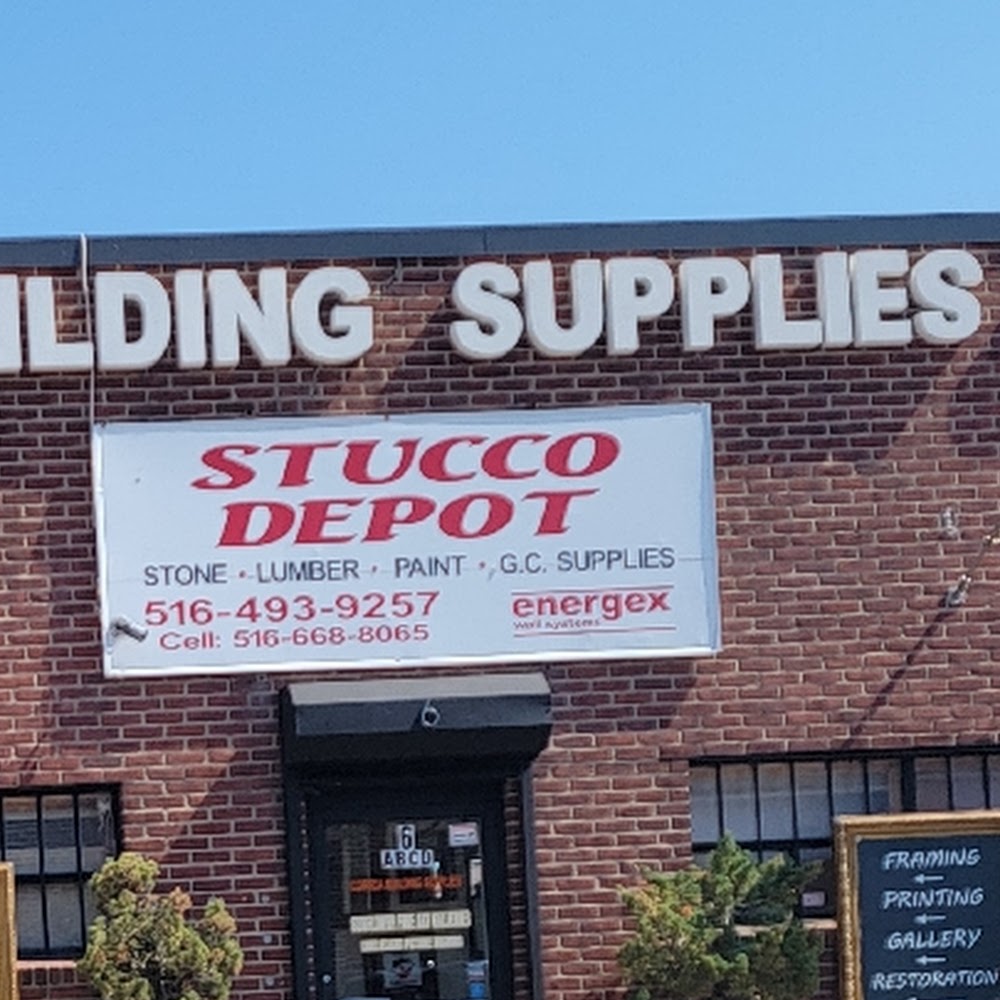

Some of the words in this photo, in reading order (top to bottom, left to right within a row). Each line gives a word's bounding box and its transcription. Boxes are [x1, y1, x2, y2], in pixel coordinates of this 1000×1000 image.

[449, 249, 984, 360] SUPPLIES
[191, 431, 622, 492] STUCCO
[215, 488, 601, 548] DEPOT
[143, 563, 228, 587] STONE
[256, 559, 359, 584] LUMBER
[394, 555, 467, 579] PAINT
[499, 551, 548, 575] G.C.
[557, 546, 676, 572] SUPPLIES
[144, 590, 441, 626] 516-493-9257
[512, 591, 672, 621] energex
[159, 631, 221, 651] Cell:
[233, 624, 430, 649] 516-668-8065
[401, 826, 413, 849] 6
[881, 849, 981, 870] FRAMING
[882, 887, 985, 909] PRINTING
[886, 928, 983, 950] GALLERY
[871, 969, 1000, 991] RESTORATION
